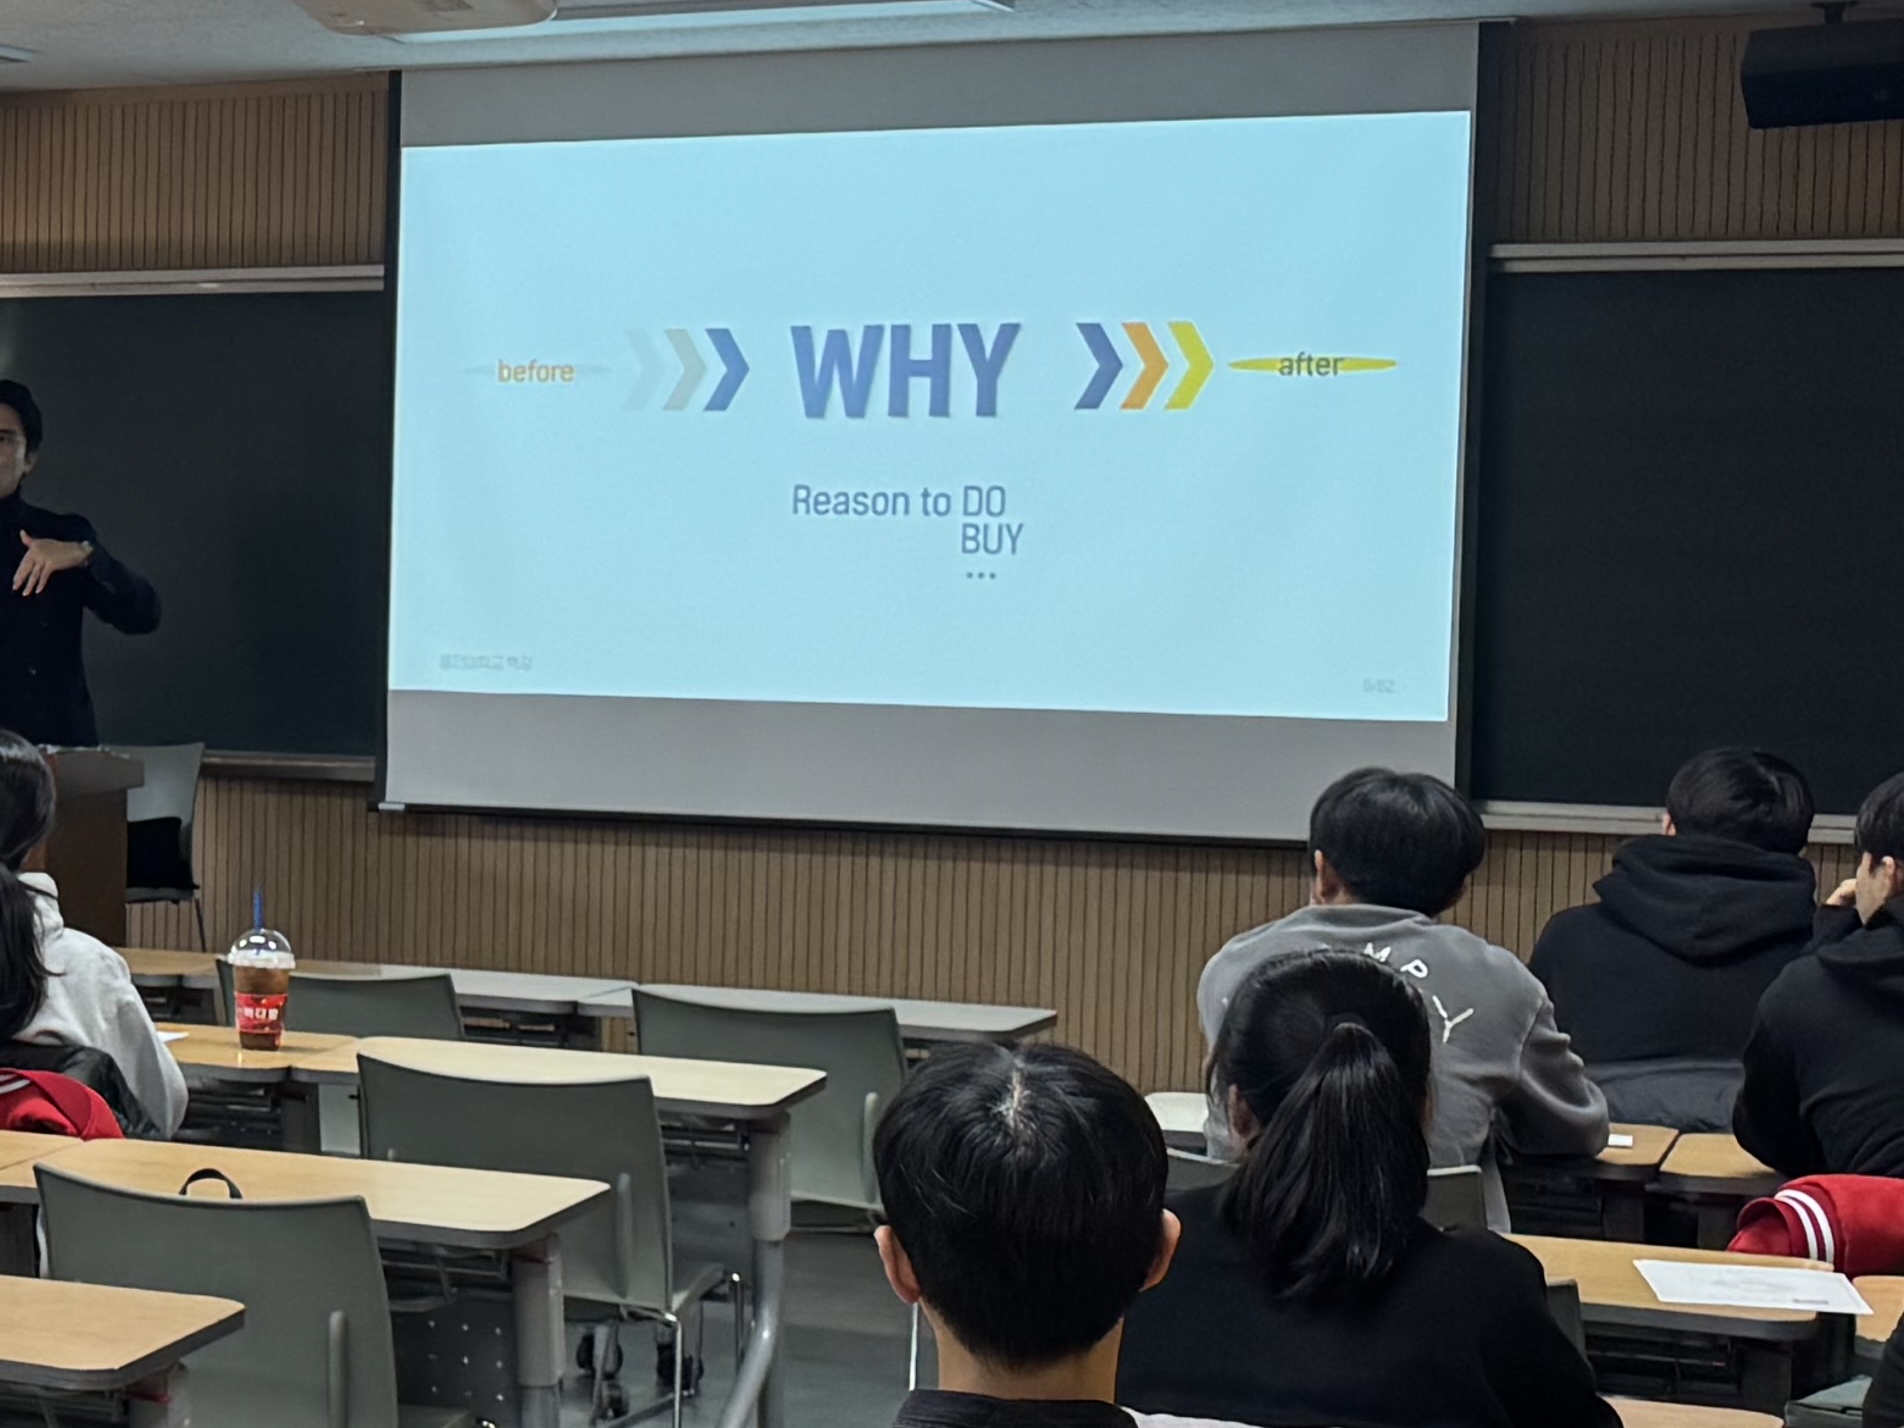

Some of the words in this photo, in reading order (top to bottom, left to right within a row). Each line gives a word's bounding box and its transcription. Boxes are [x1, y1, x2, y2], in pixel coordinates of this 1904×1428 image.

[497, 358, 576, 383] before
[790, 323, 1021, 419] WHY
[1278, 351, 1345, 376] after
[792, 484, 910, 515] Reason
[921, 487, 952, 517] to
[963, 485, 1006, 517] DO
[961, 523, 1024, 555] BUY
